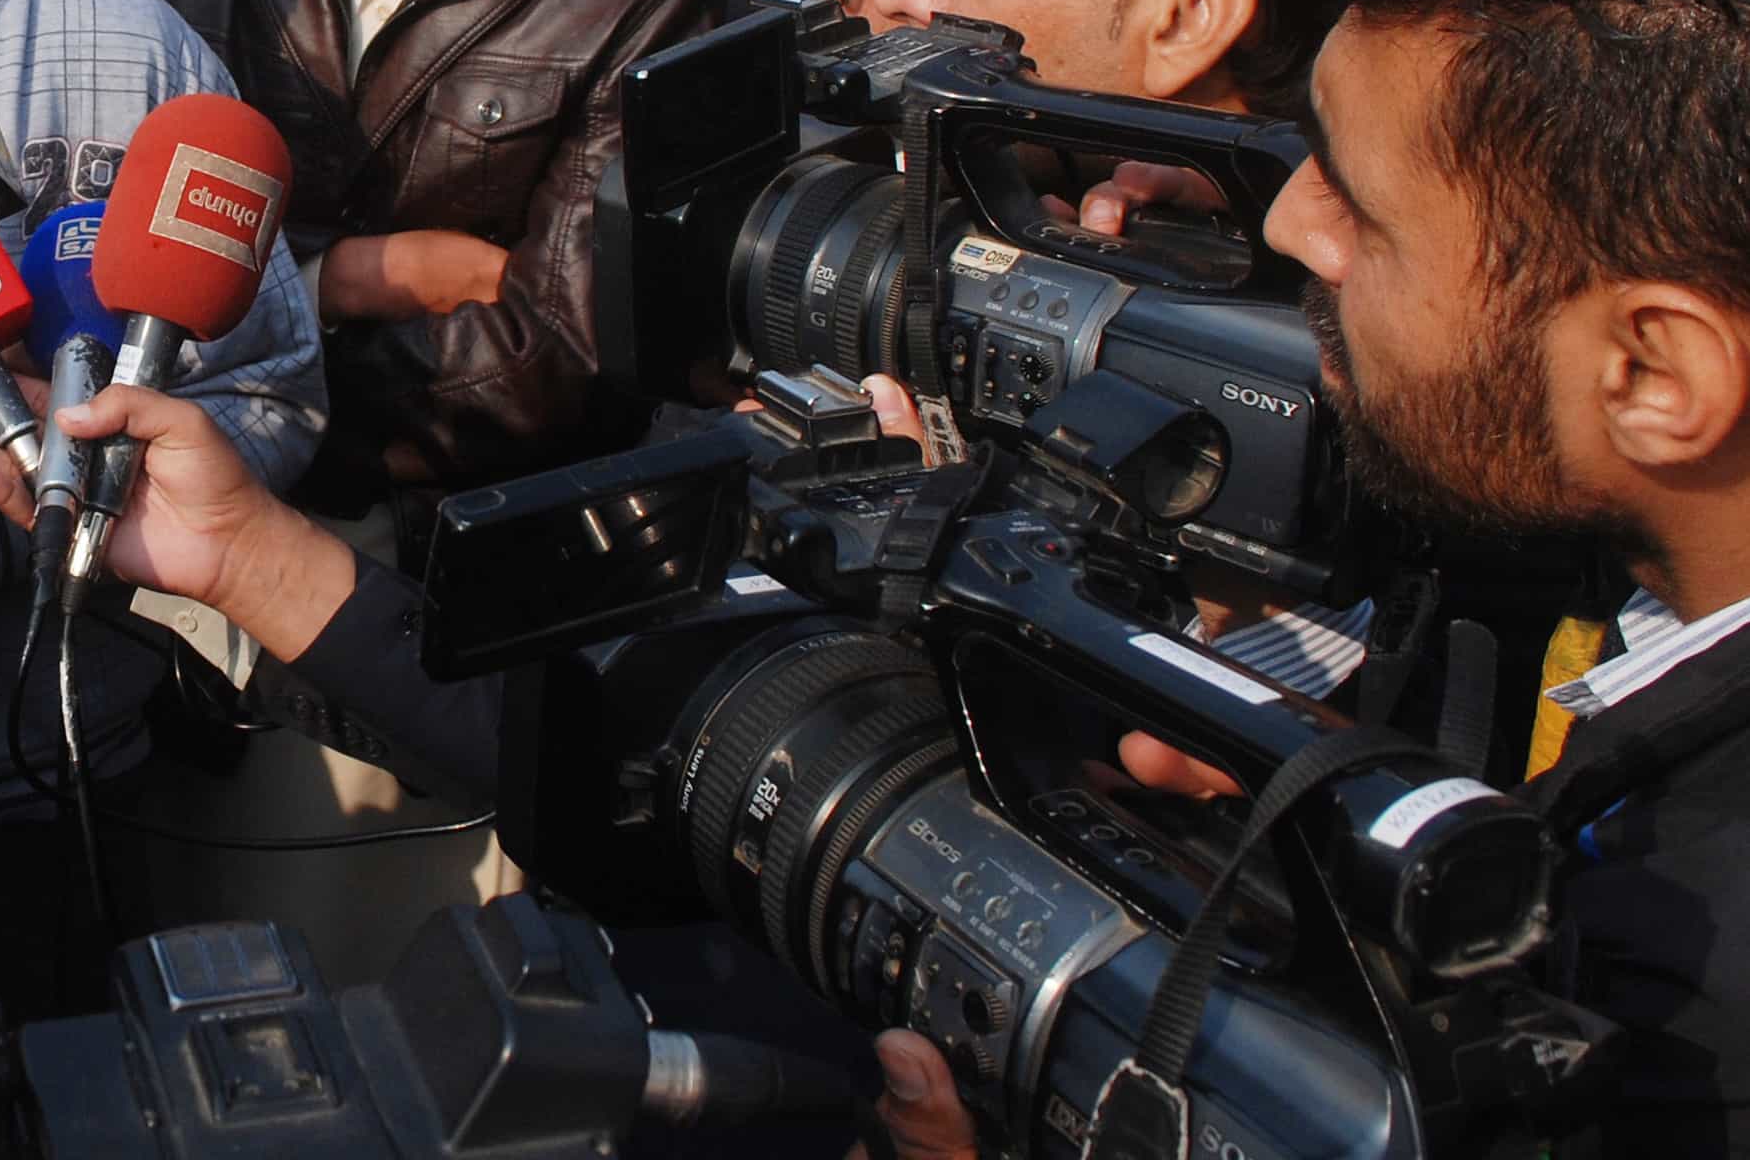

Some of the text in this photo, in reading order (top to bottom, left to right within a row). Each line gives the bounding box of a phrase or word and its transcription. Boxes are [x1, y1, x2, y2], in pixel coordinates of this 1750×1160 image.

[187, 185, 259, 228] dunya
[816, 266, 838, 282] 20x
[1221, 382, 1299, 418] SONY
[756, 777, 781, 807] 20x
